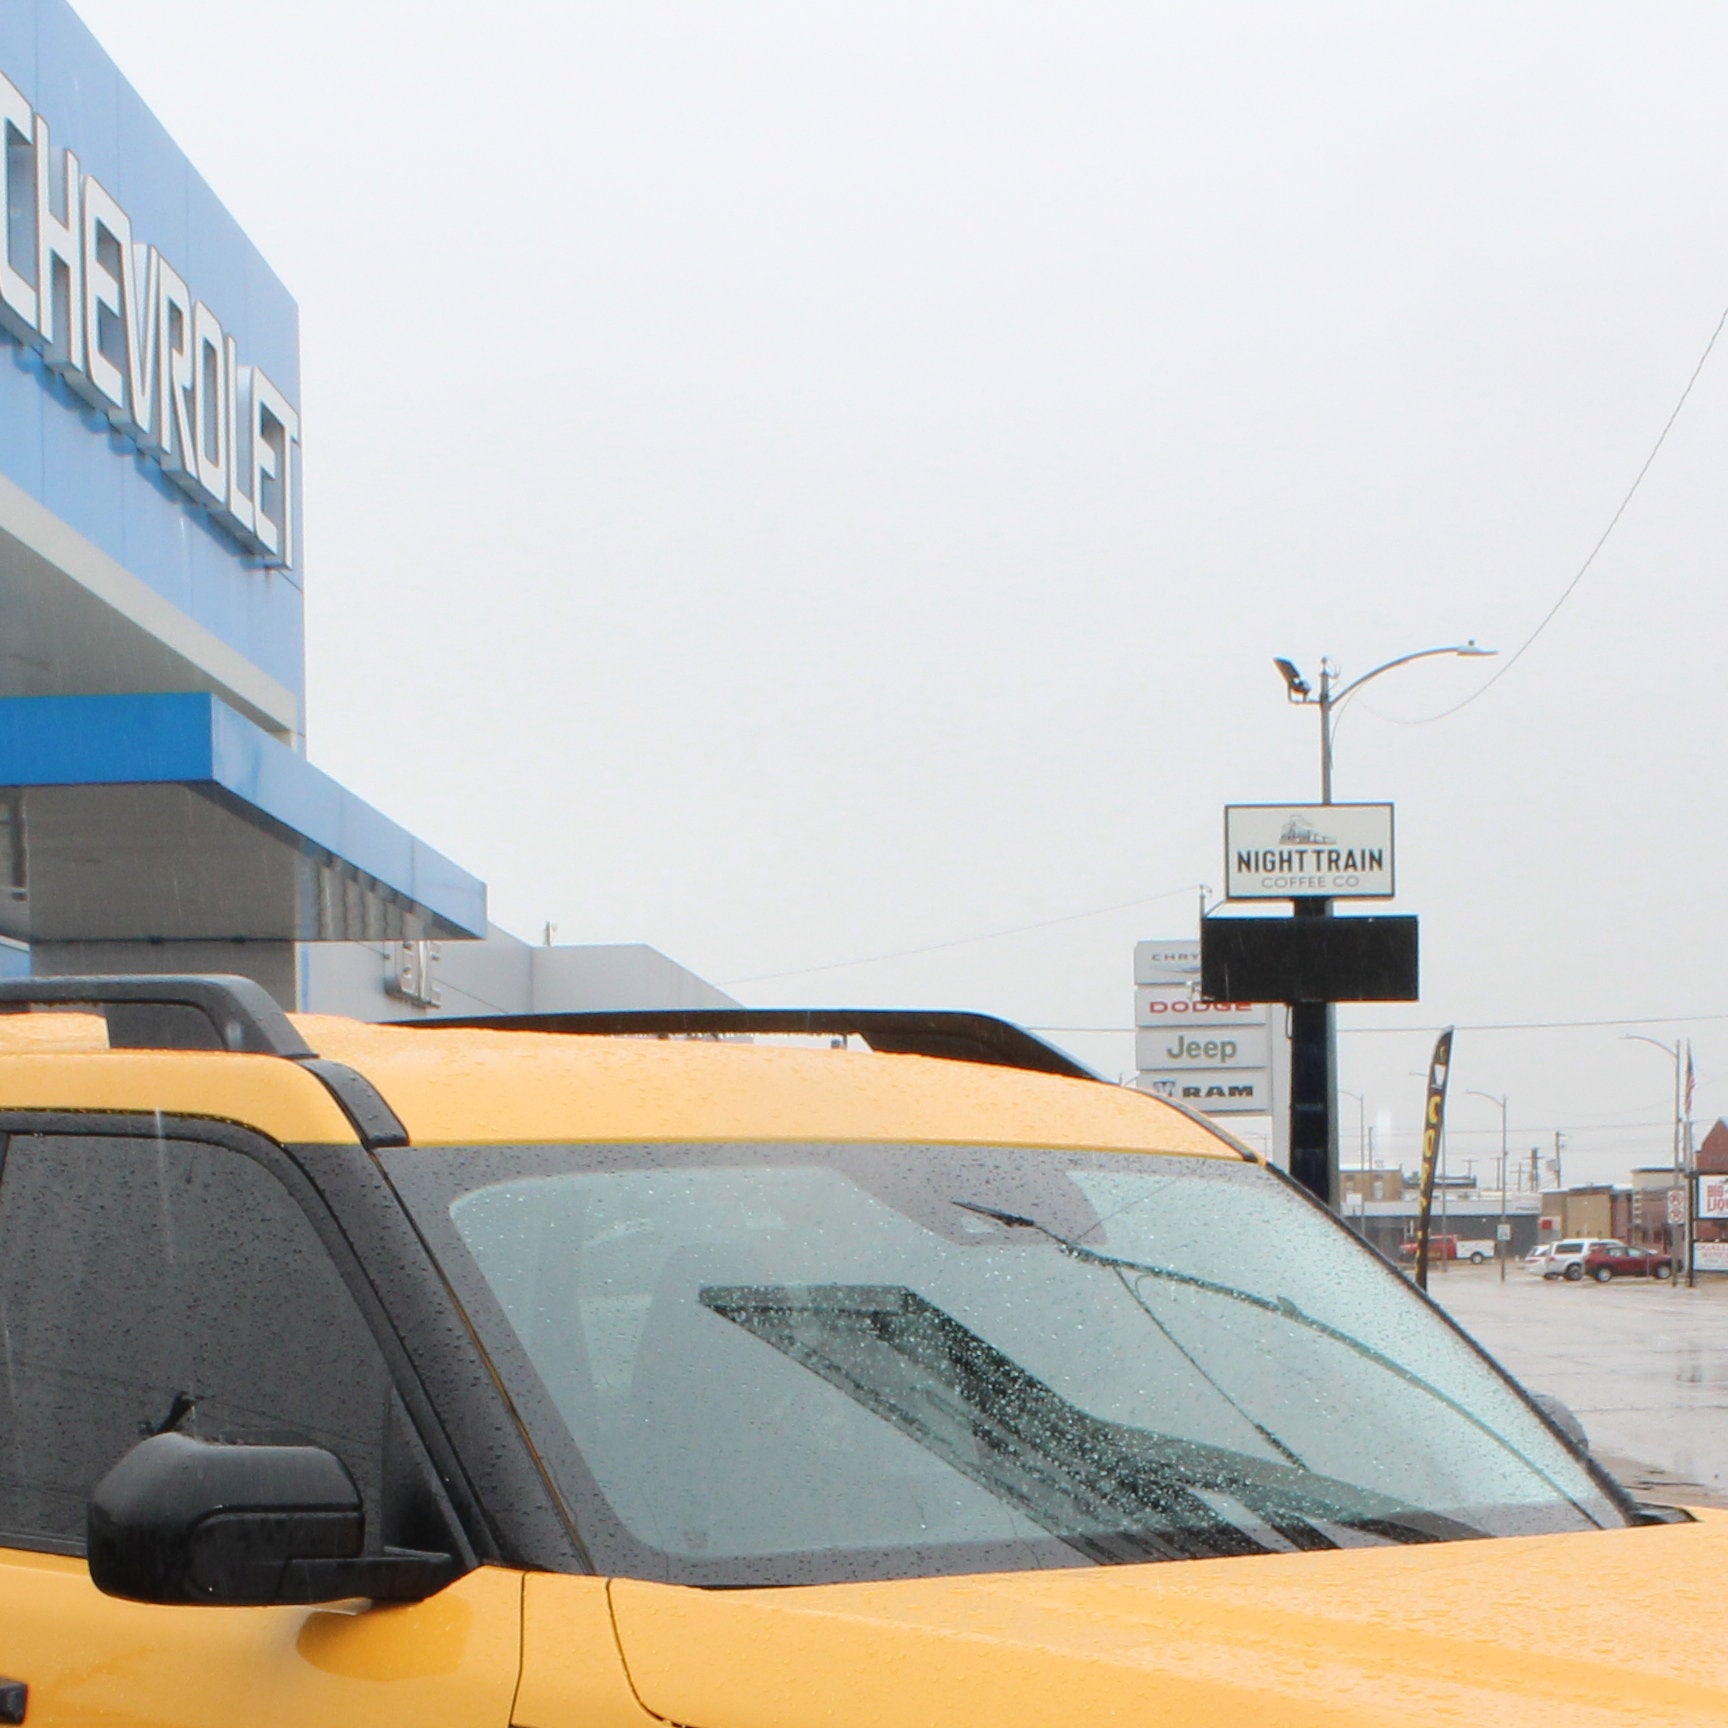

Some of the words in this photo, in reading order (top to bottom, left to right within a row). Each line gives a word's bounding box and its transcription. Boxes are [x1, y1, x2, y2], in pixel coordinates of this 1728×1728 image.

[1237, 850, 1306, 873] NIGHT
[1310, 848, 1383, 872] TRAIN
[1261, 876, 1327, 889] COFFEE
[1332, 875, 1360, 888] CO
[1149, 1000, 1252, 1013] DODGE
[1166, 1035, 1238, 1063] Jeep
[1183, 1085, 1254, 1098] RAM
[1706, 1185, 1724, 1198] BIG
